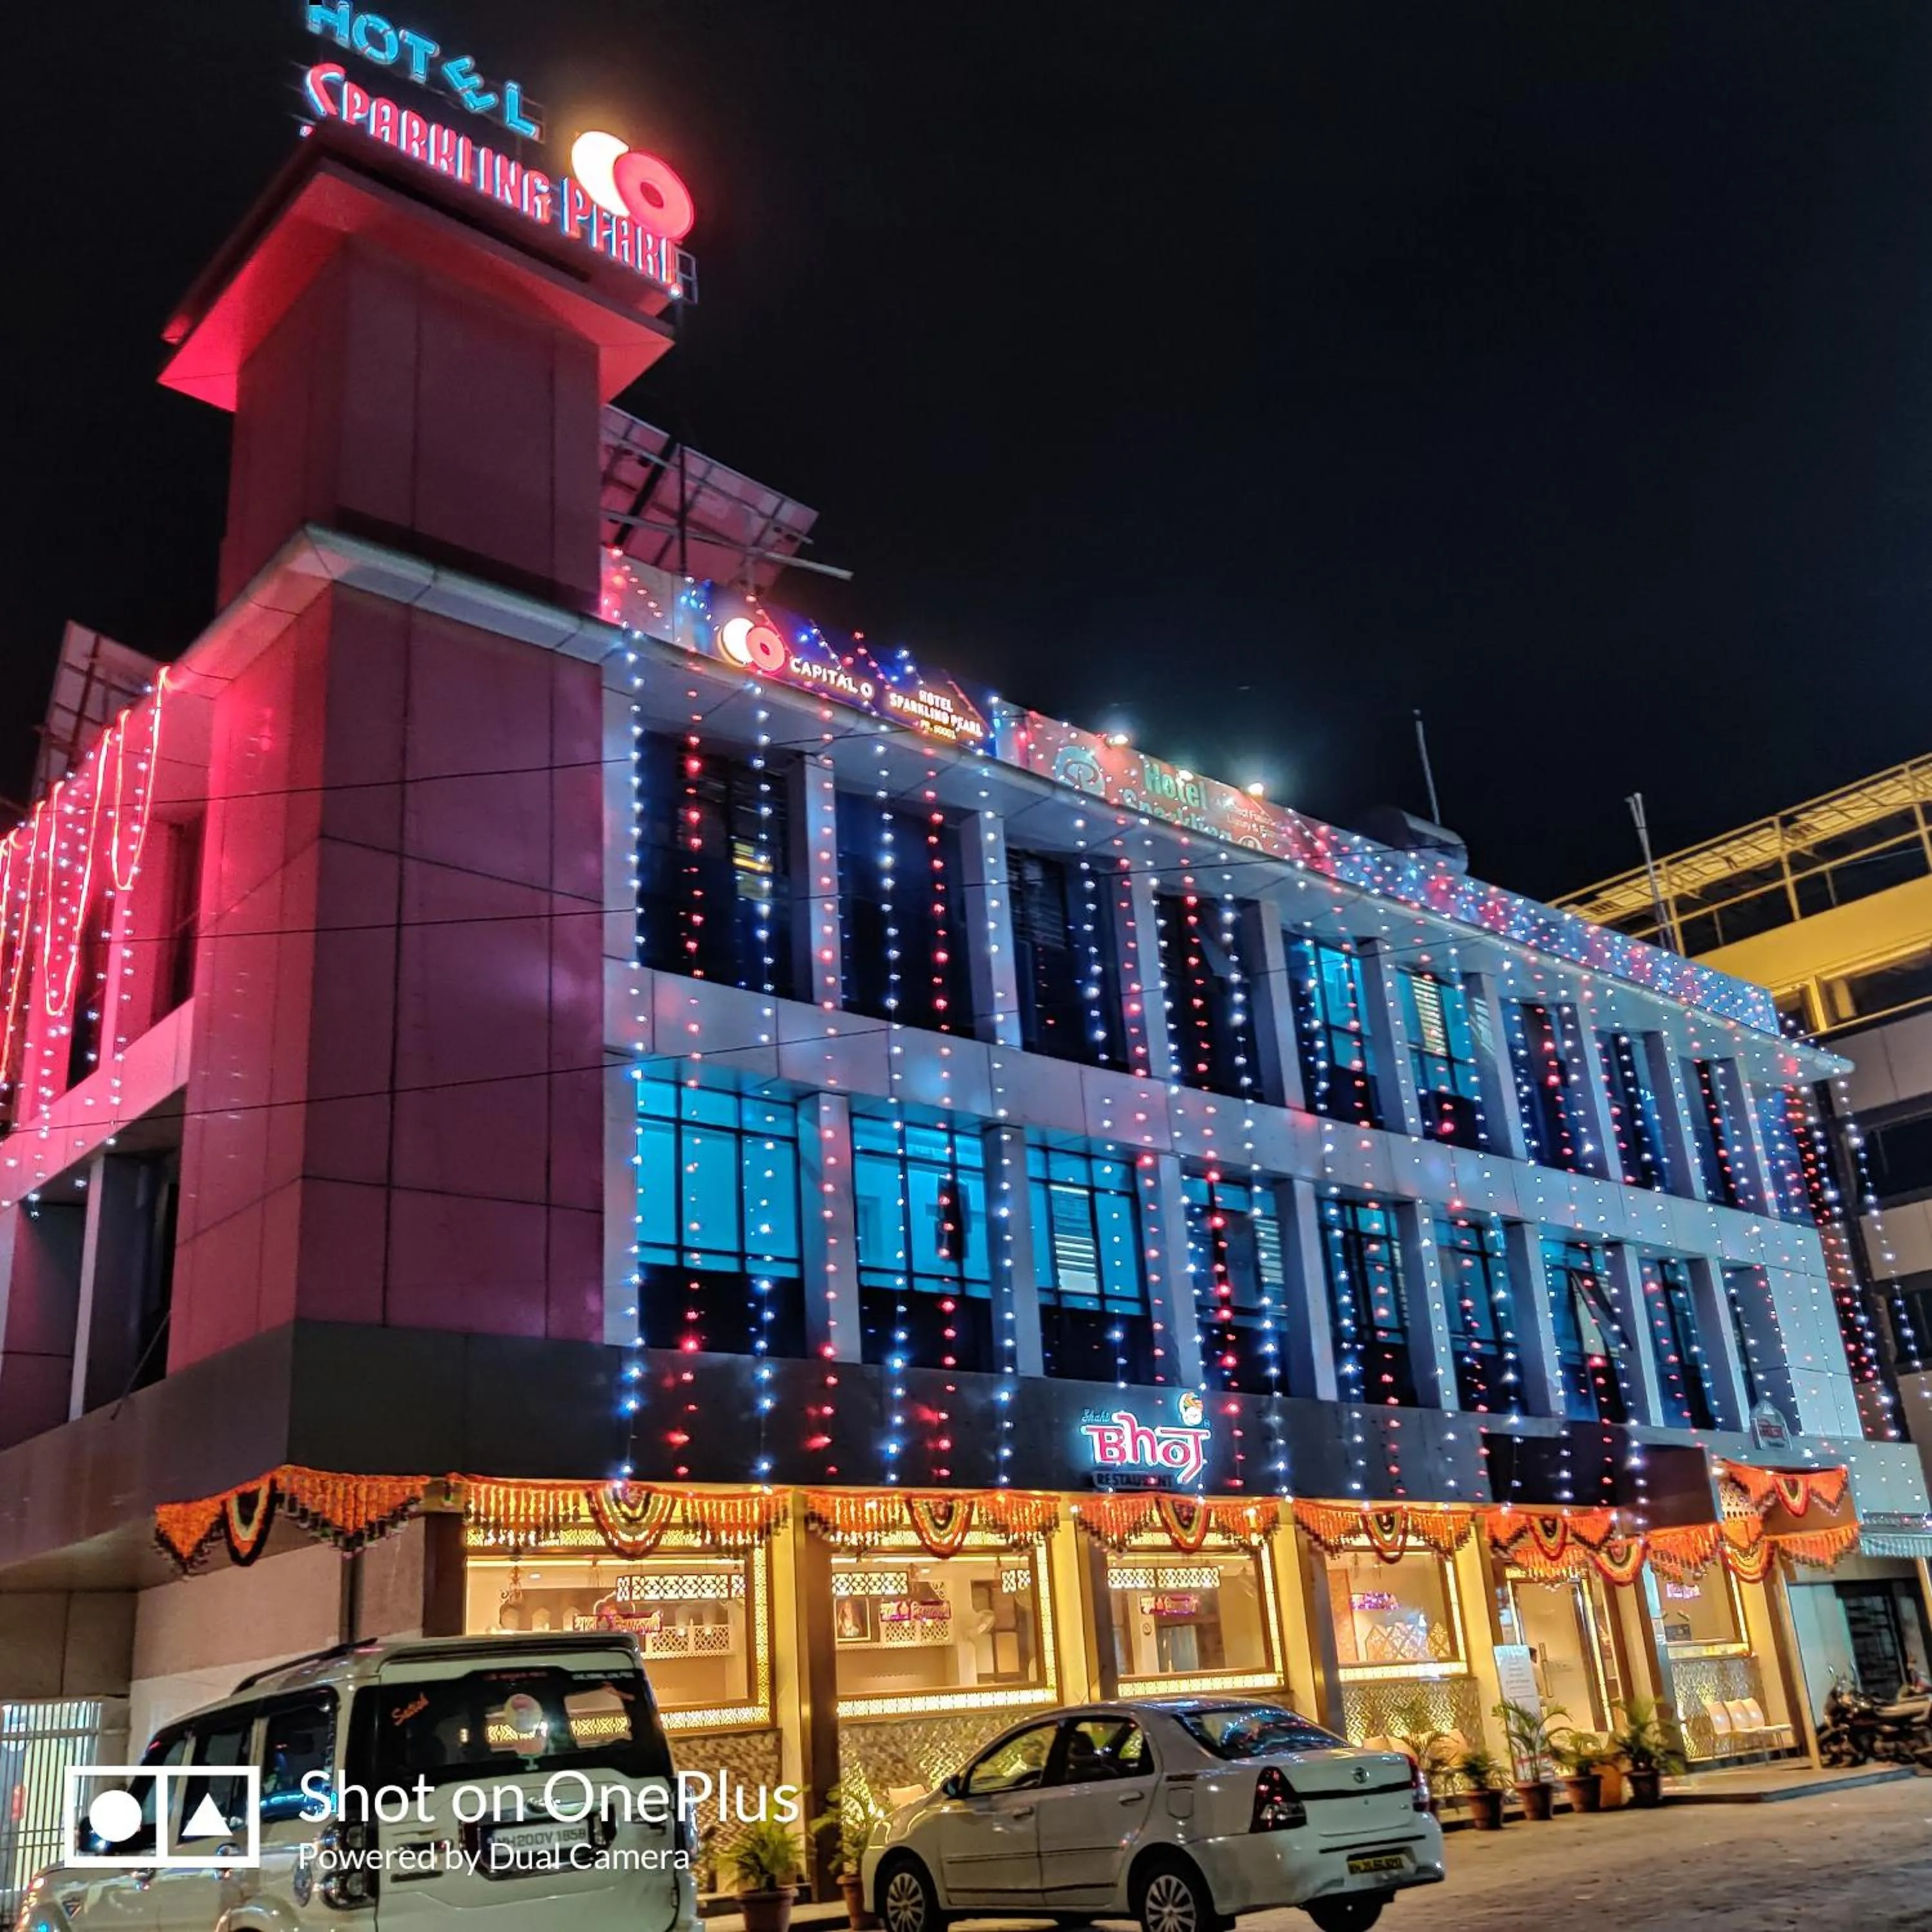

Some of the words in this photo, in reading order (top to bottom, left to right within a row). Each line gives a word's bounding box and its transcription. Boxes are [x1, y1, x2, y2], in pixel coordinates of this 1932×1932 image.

[307, 0, 540, 138] HOTEL
[790, 657, 858, 694] CAPITAL
[860, 682, 873, 697] O
[889, 692, 950, 724] SPARKLING
[950, 714, 984, 737] PEARL
[918, 690, 954, 713] HOTEL
[1144, 759, 1208, 810] Hotel
[1081, 1410, 1211, 1484] Bhoj
